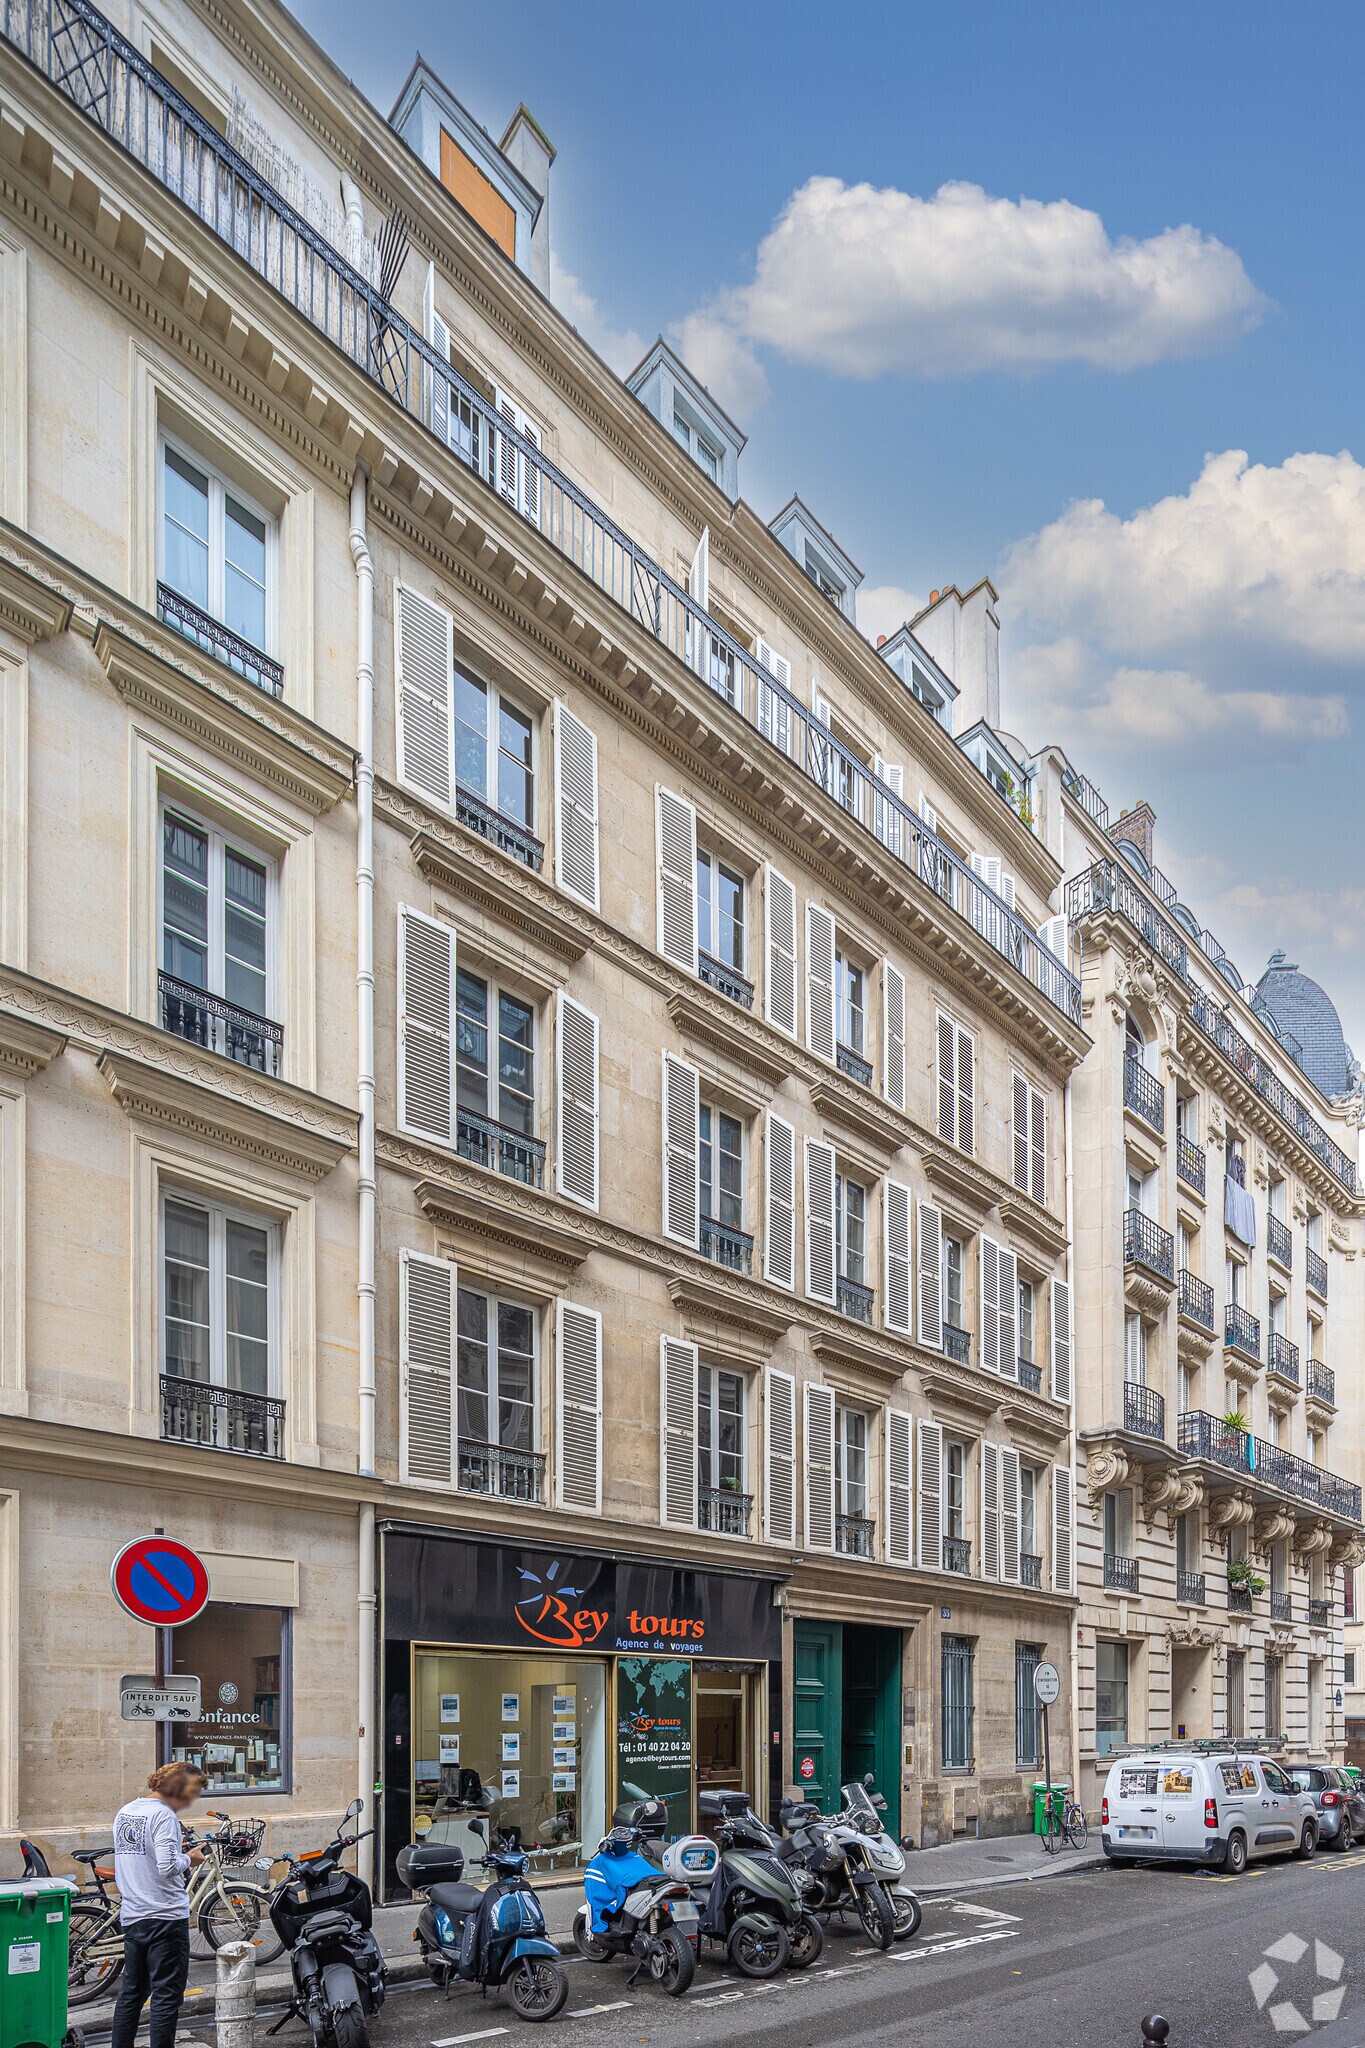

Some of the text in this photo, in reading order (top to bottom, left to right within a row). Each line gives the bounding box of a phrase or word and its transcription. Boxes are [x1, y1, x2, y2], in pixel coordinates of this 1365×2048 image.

[942, 1608, 950, 1618] 35
[626, 1609, 705, 1639] tours
[615, 1637, 703, 1654] Agence de voyages
[126, 1693, 197, 1703] INTERDIT SAUF
[658, 1718, 681, 1726] tours
[618, 1742, 631, 1752] Tél
[637, 1742, 647, 1752] 01
[648, 1742, 659, 1752] 40
[660, 1742, 669, 1751] 22
[670, 1742, 680, 1751] 04
[681, 1741, 691, 1751] 20
[625, 1754, 691, 1764] agence@beytours.com
